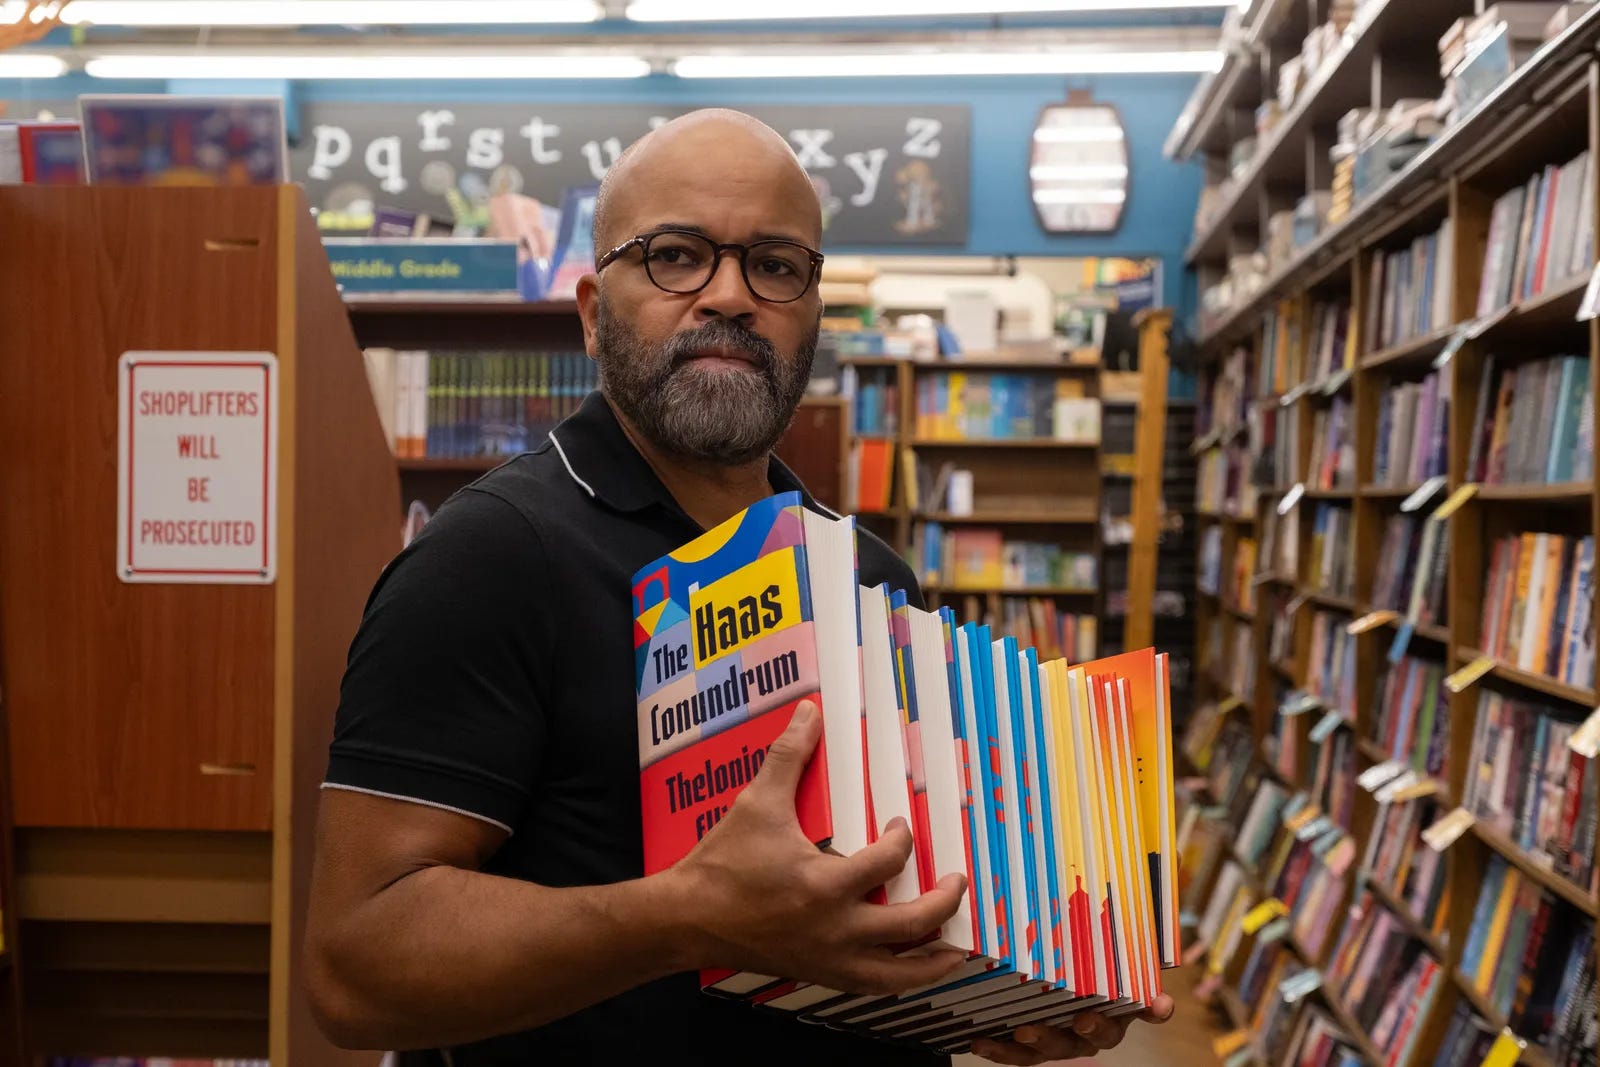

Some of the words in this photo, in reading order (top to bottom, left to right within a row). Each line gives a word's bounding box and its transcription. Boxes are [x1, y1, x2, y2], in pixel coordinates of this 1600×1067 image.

[308, 125, 351, 180] p
[365, 136, 407, 193] q
[418, 110, 454, 150] r
[467, 128, 503, 168] s
[520, 116, 561, 163] t
[790, 129, 836, 168] x
[844, 148, 888, 207] y
[902, 117, 942, 158] z
[330, 258, 394, 277] Middle
[400, 258, 460, 277] Grade
[140, 391, 258, 417] SHOPLIFTERS
[177, 434, 219, 458] WILL
[187, 477, 210, 502] BE
[140, 520, 255, 545] PROSECUTED
[653, 643, 689, 684] The
[695, 585, 783, 662] Haas
[651, 650, 800, 746] Conundrum
[666, 745, 772, 814] Thelonio
